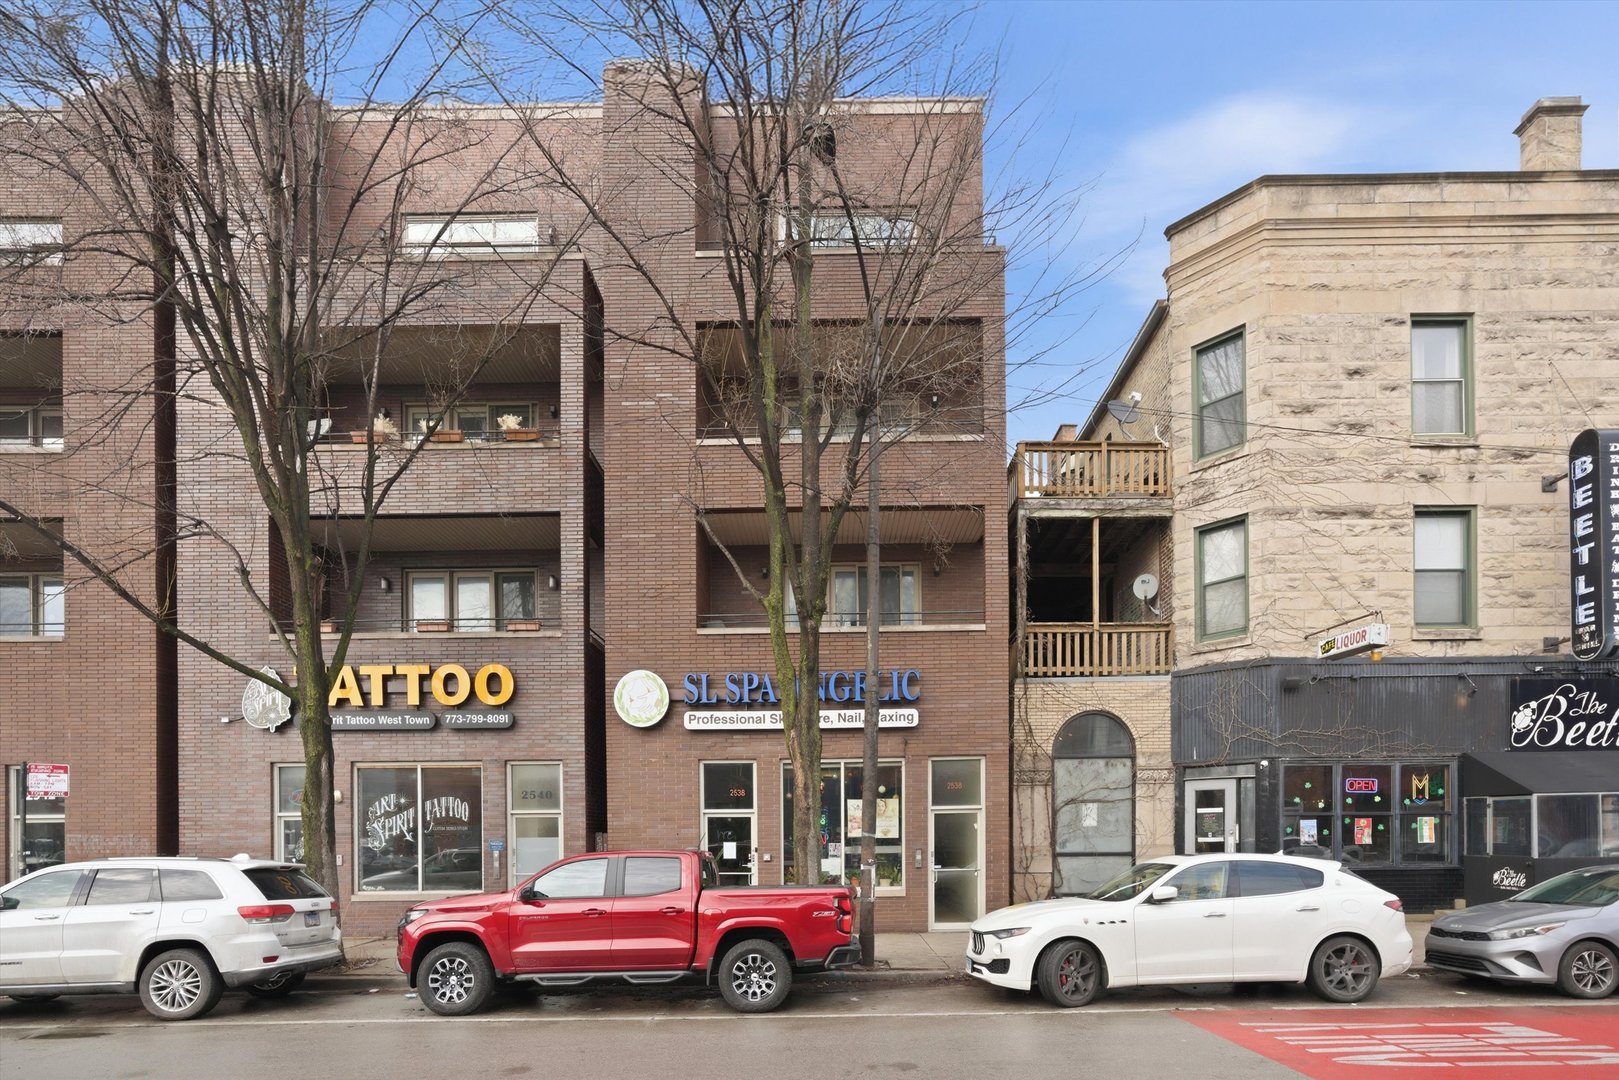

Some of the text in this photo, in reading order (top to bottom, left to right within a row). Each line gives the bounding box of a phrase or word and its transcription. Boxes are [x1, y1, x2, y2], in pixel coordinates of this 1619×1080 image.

[1571, 455, 1596, 625] BEETLE
[1321, 629, 1367, 653] CAFE LIQUOR
[293, 664, 514, 706] ATTOO
[683, 672, 718, 704] SL
[725, 672, 778, 704] SPA
[1511, 683, 1619, 747] Beet
[1569, 692, 1608, 716] The
[345, 715, 376, 725] Tattoo
[378, 715, 402, 725] West
[404, 715, 430, 725] Town
[445, 714, 509, 724] 773-799-8091
[688, 713, 766, 725] Professional
[819, 714, 834, 726] re,
[879, 711, 914, 724] axing
[521, 790, 553, 800] 2540
[1347, 781, 1377, 791] OPEN
[425, 796, 469, 829] TATTOO
[368, 806, 415, 850] SPIRIT
[1493, 867, 1526, 887] Beetle
